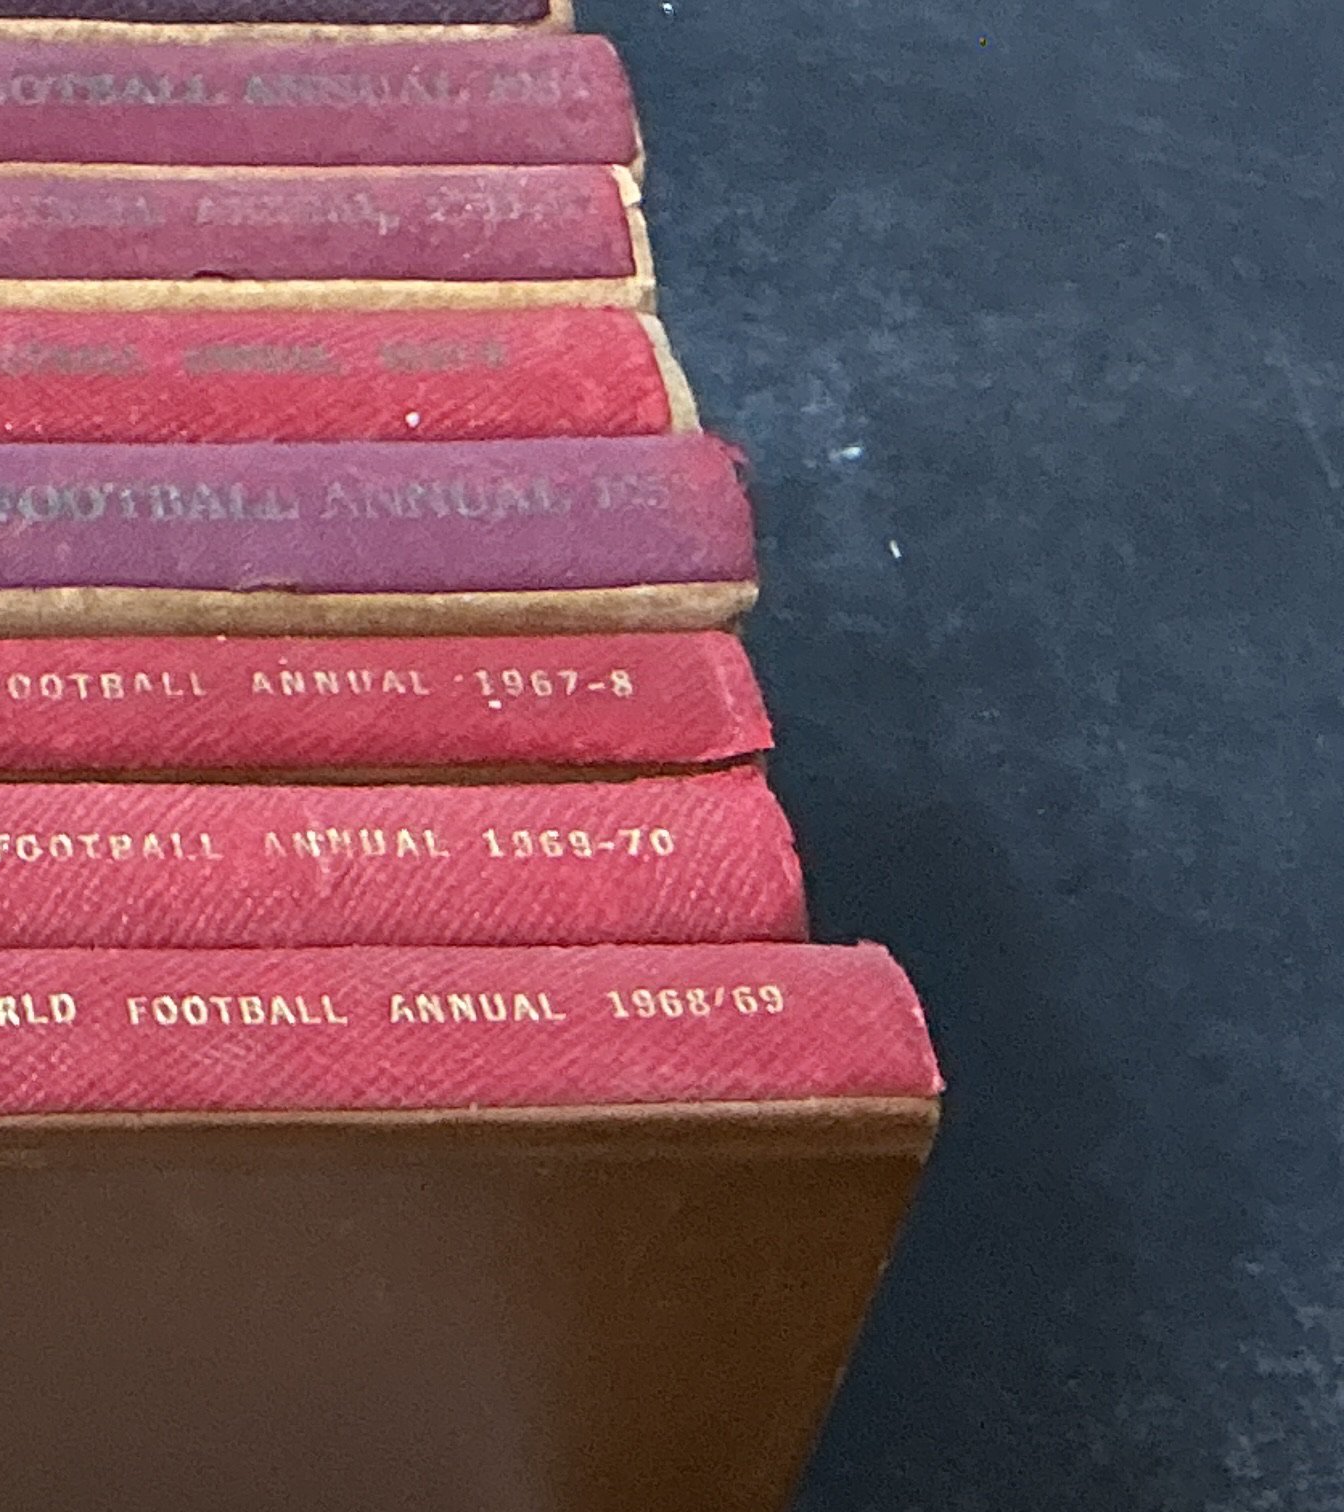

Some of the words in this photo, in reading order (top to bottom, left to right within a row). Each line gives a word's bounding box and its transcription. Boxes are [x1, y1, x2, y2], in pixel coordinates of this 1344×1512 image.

[320, 480, 571, 518] ANNUAL
[251, 670, 430, 697] ANNUAL
[477, 669, 634, 698] 1967-8
[264, 829, 450, 859] ANNUAL
[482, 828, 675, 858] 1969-70
[128, 995, 347, 1025] FOOTBALL
[389, 993, 567, 1023] ANNUAL
